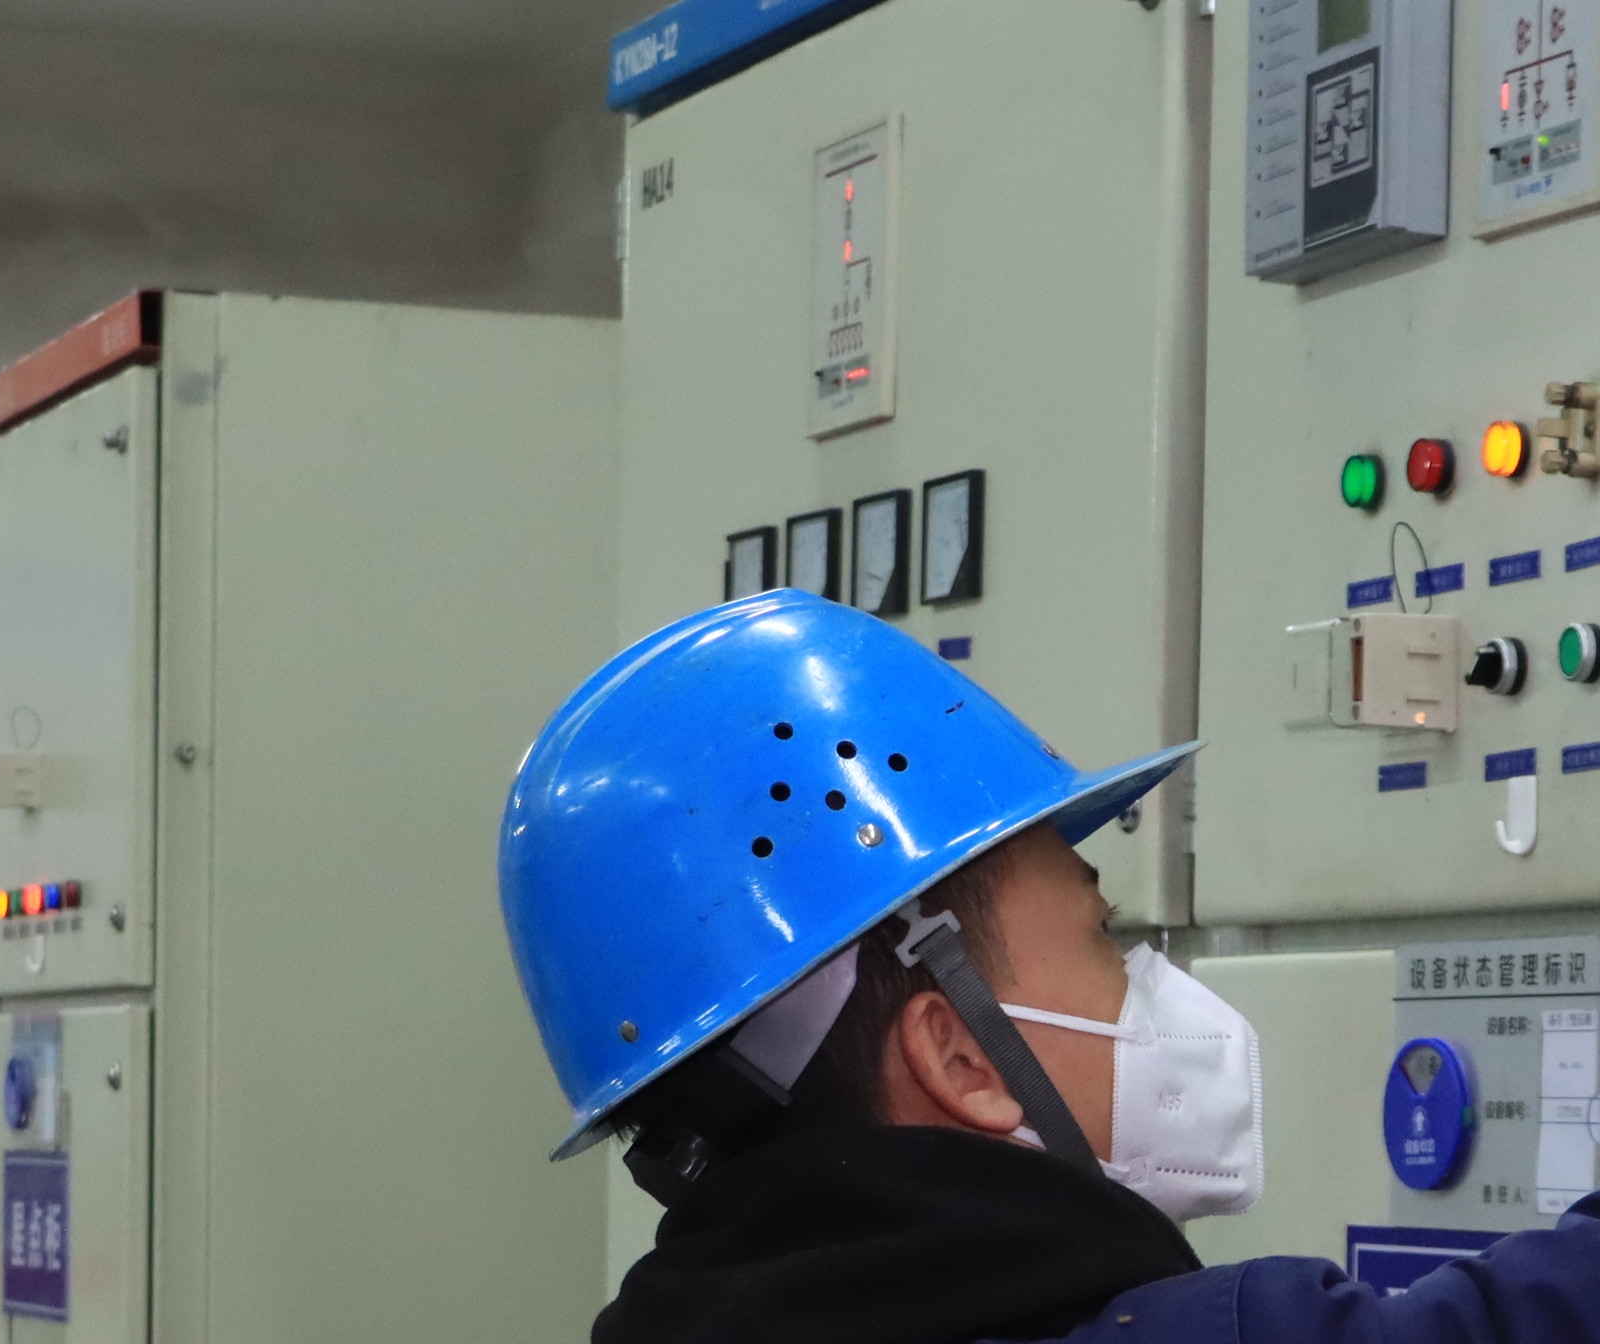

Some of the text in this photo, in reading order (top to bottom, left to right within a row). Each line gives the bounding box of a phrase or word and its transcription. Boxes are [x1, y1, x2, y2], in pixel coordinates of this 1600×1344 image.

[1409, 951, 1588, 991] 设备状态管理标识
